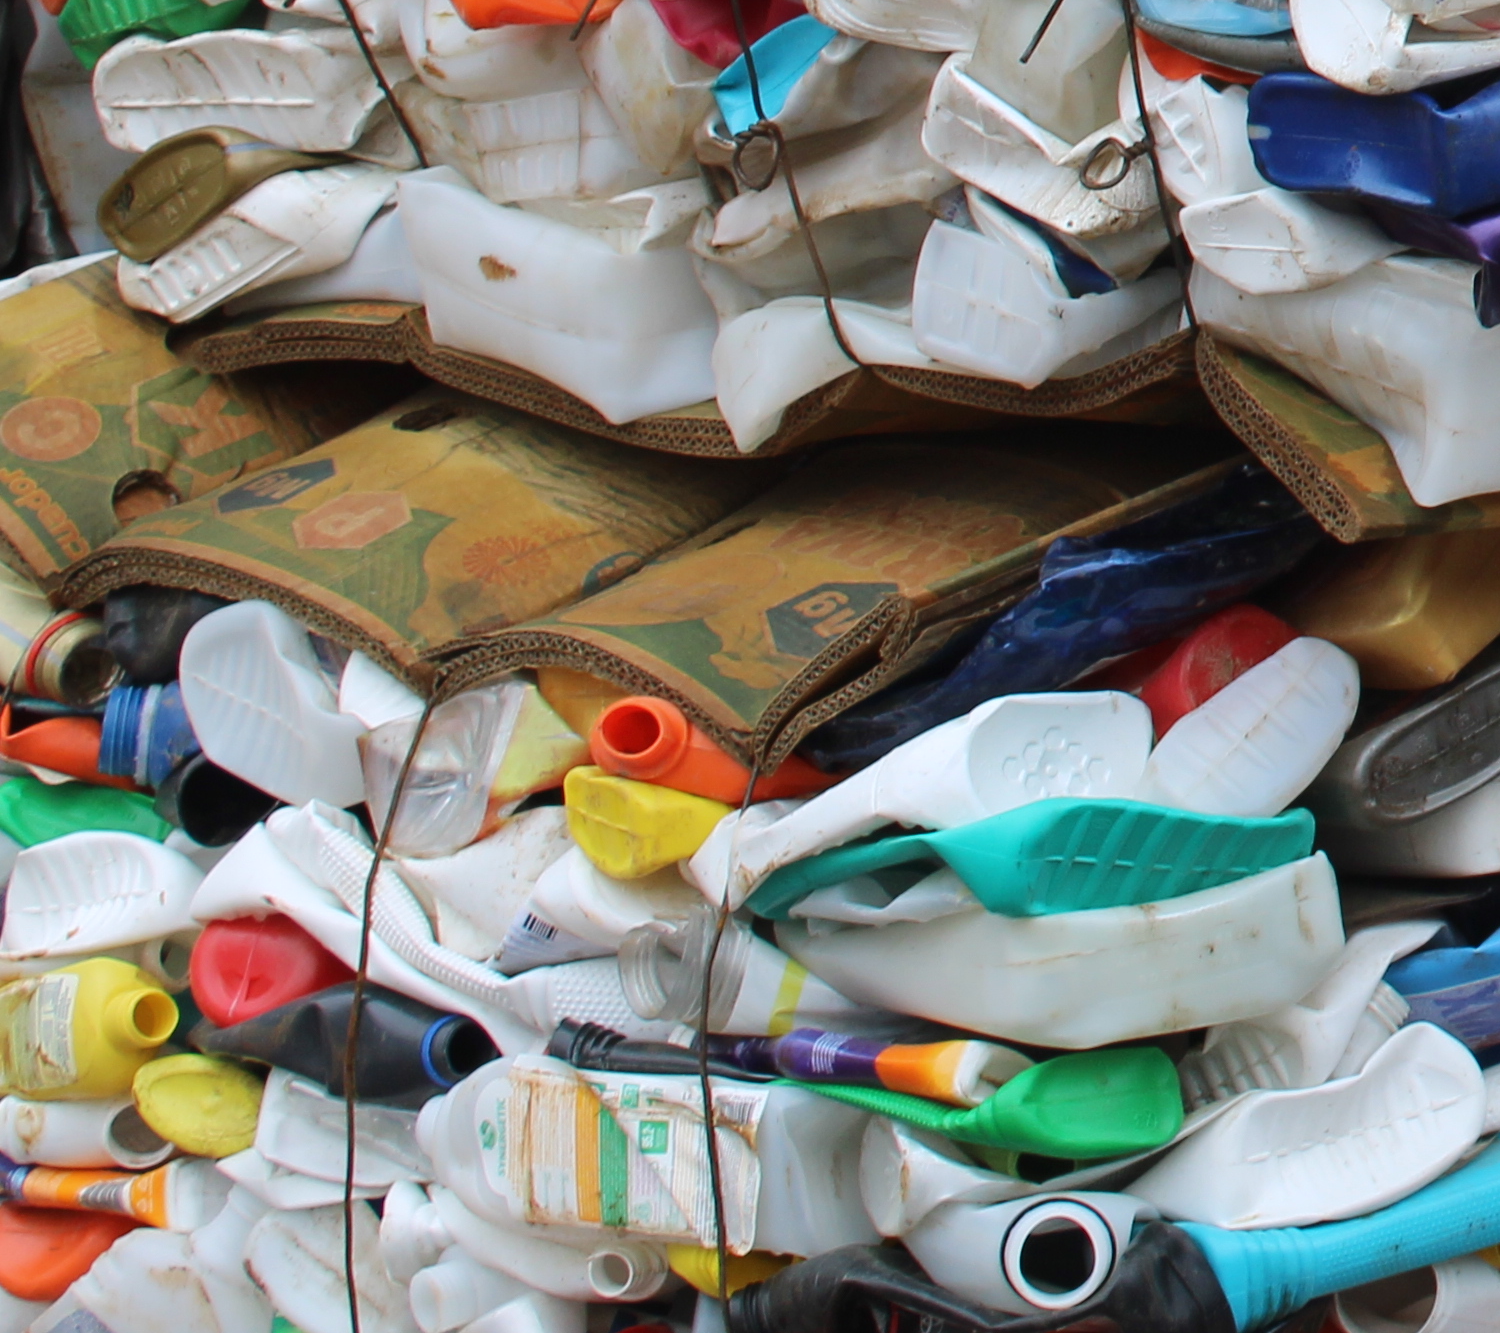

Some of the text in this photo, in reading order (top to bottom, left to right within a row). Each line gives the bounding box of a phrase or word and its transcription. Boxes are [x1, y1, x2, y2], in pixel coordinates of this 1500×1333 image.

[146, 385, 268, 459] K
[242, 469, 312, 502] Mg
[0, 466, 92, 561] cuador
[314, 507, 390, 540] P
